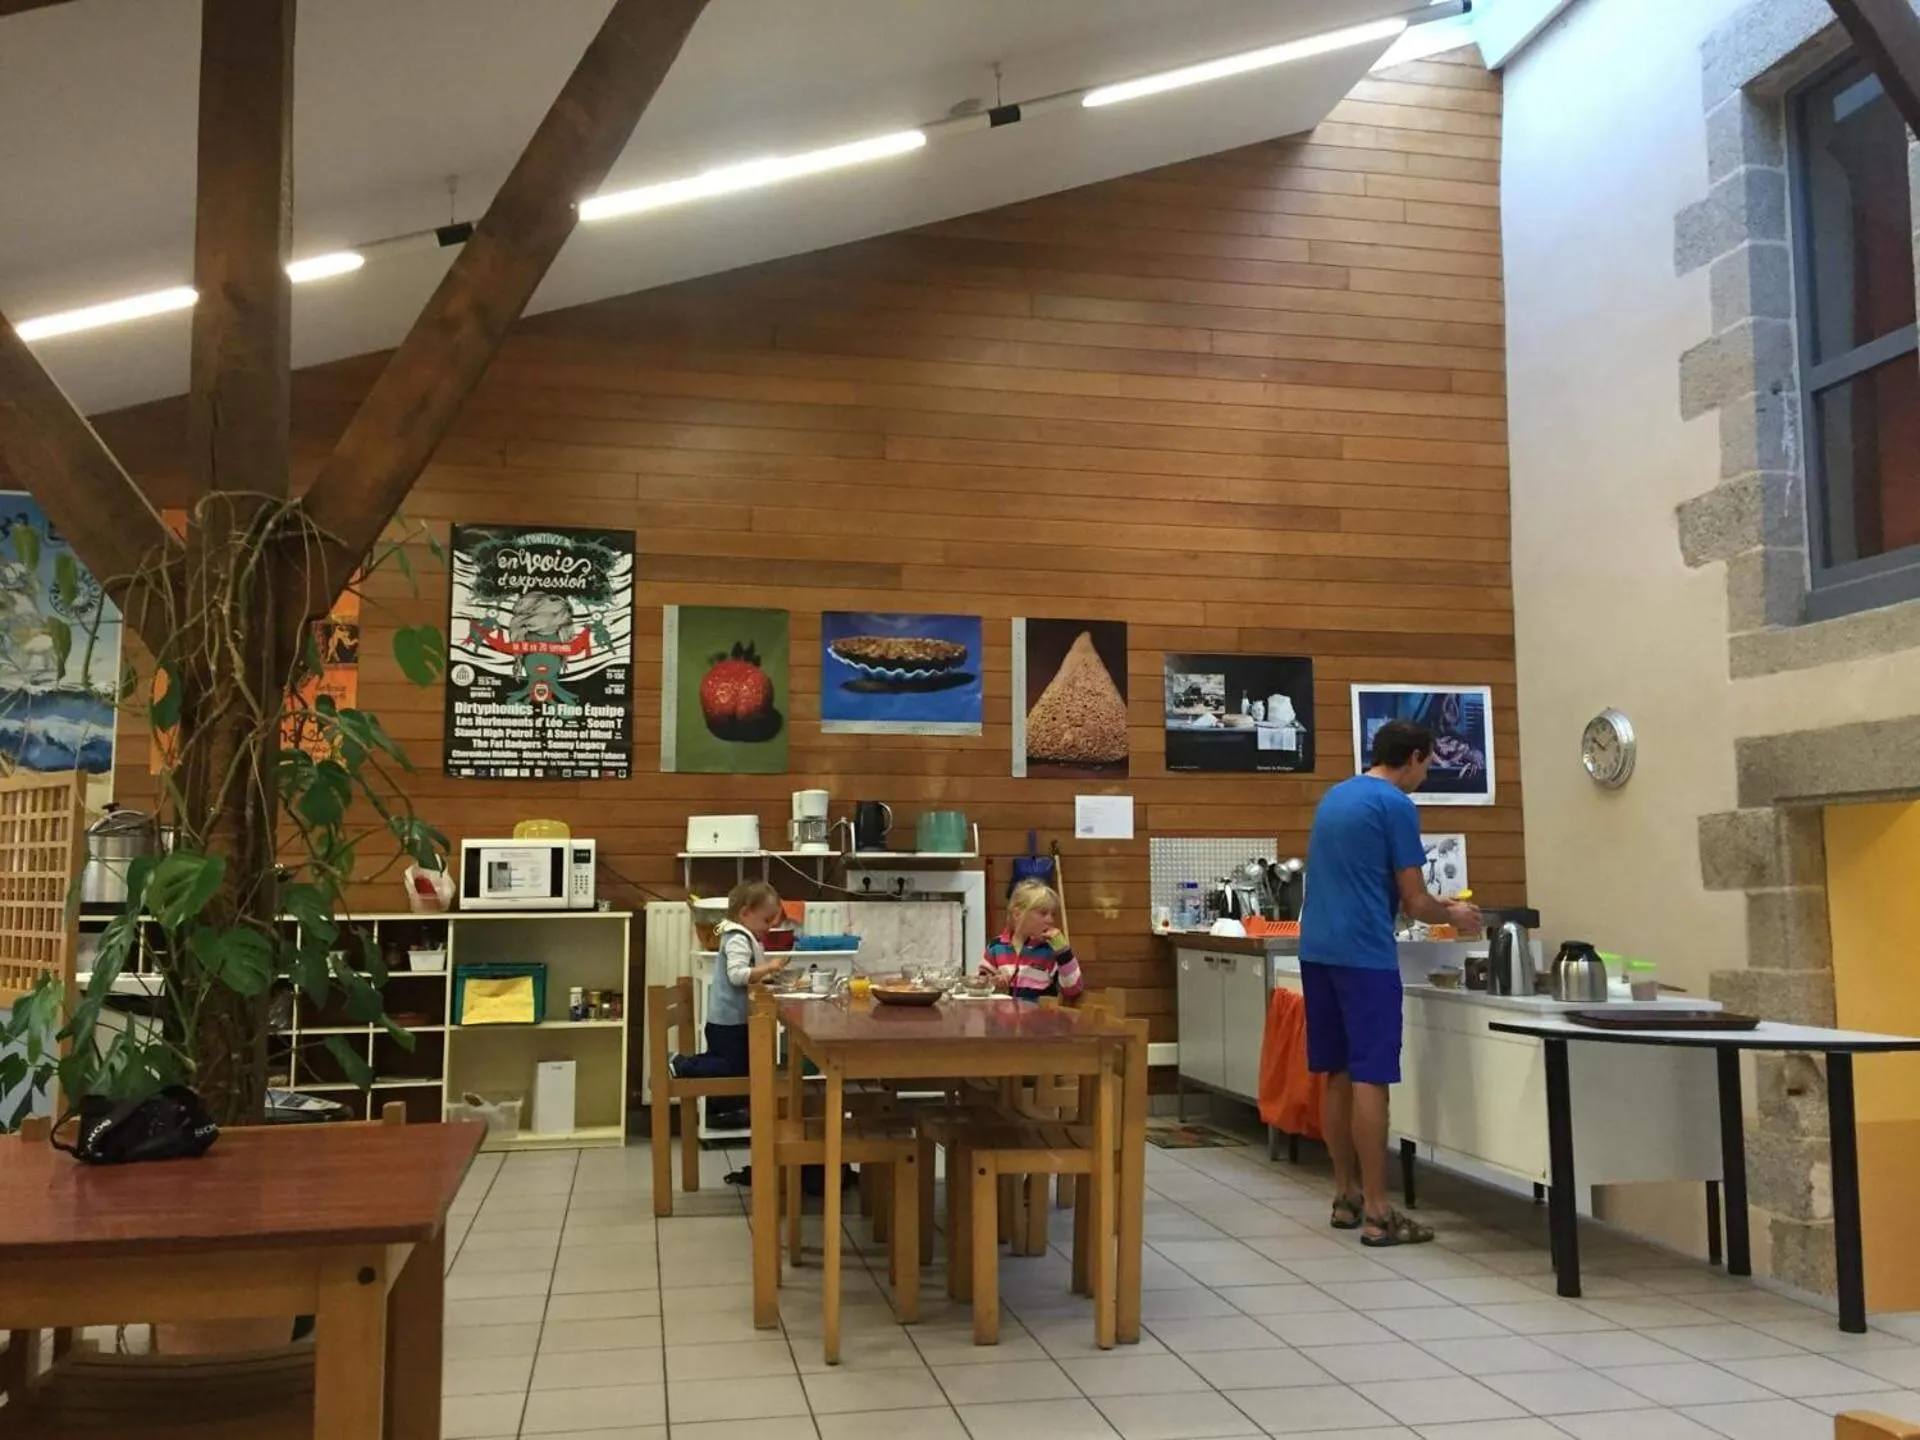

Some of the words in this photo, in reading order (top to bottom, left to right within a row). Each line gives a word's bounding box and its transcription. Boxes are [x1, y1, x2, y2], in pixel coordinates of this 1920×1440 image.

[454, 702, 534, 715] Dirtyphonics
[542, 704, 556, 715] La
[557, 704, 583, 716] Fine
[585, 702, 625, 717] Équipe
[456, 716, 474, 726] Les
